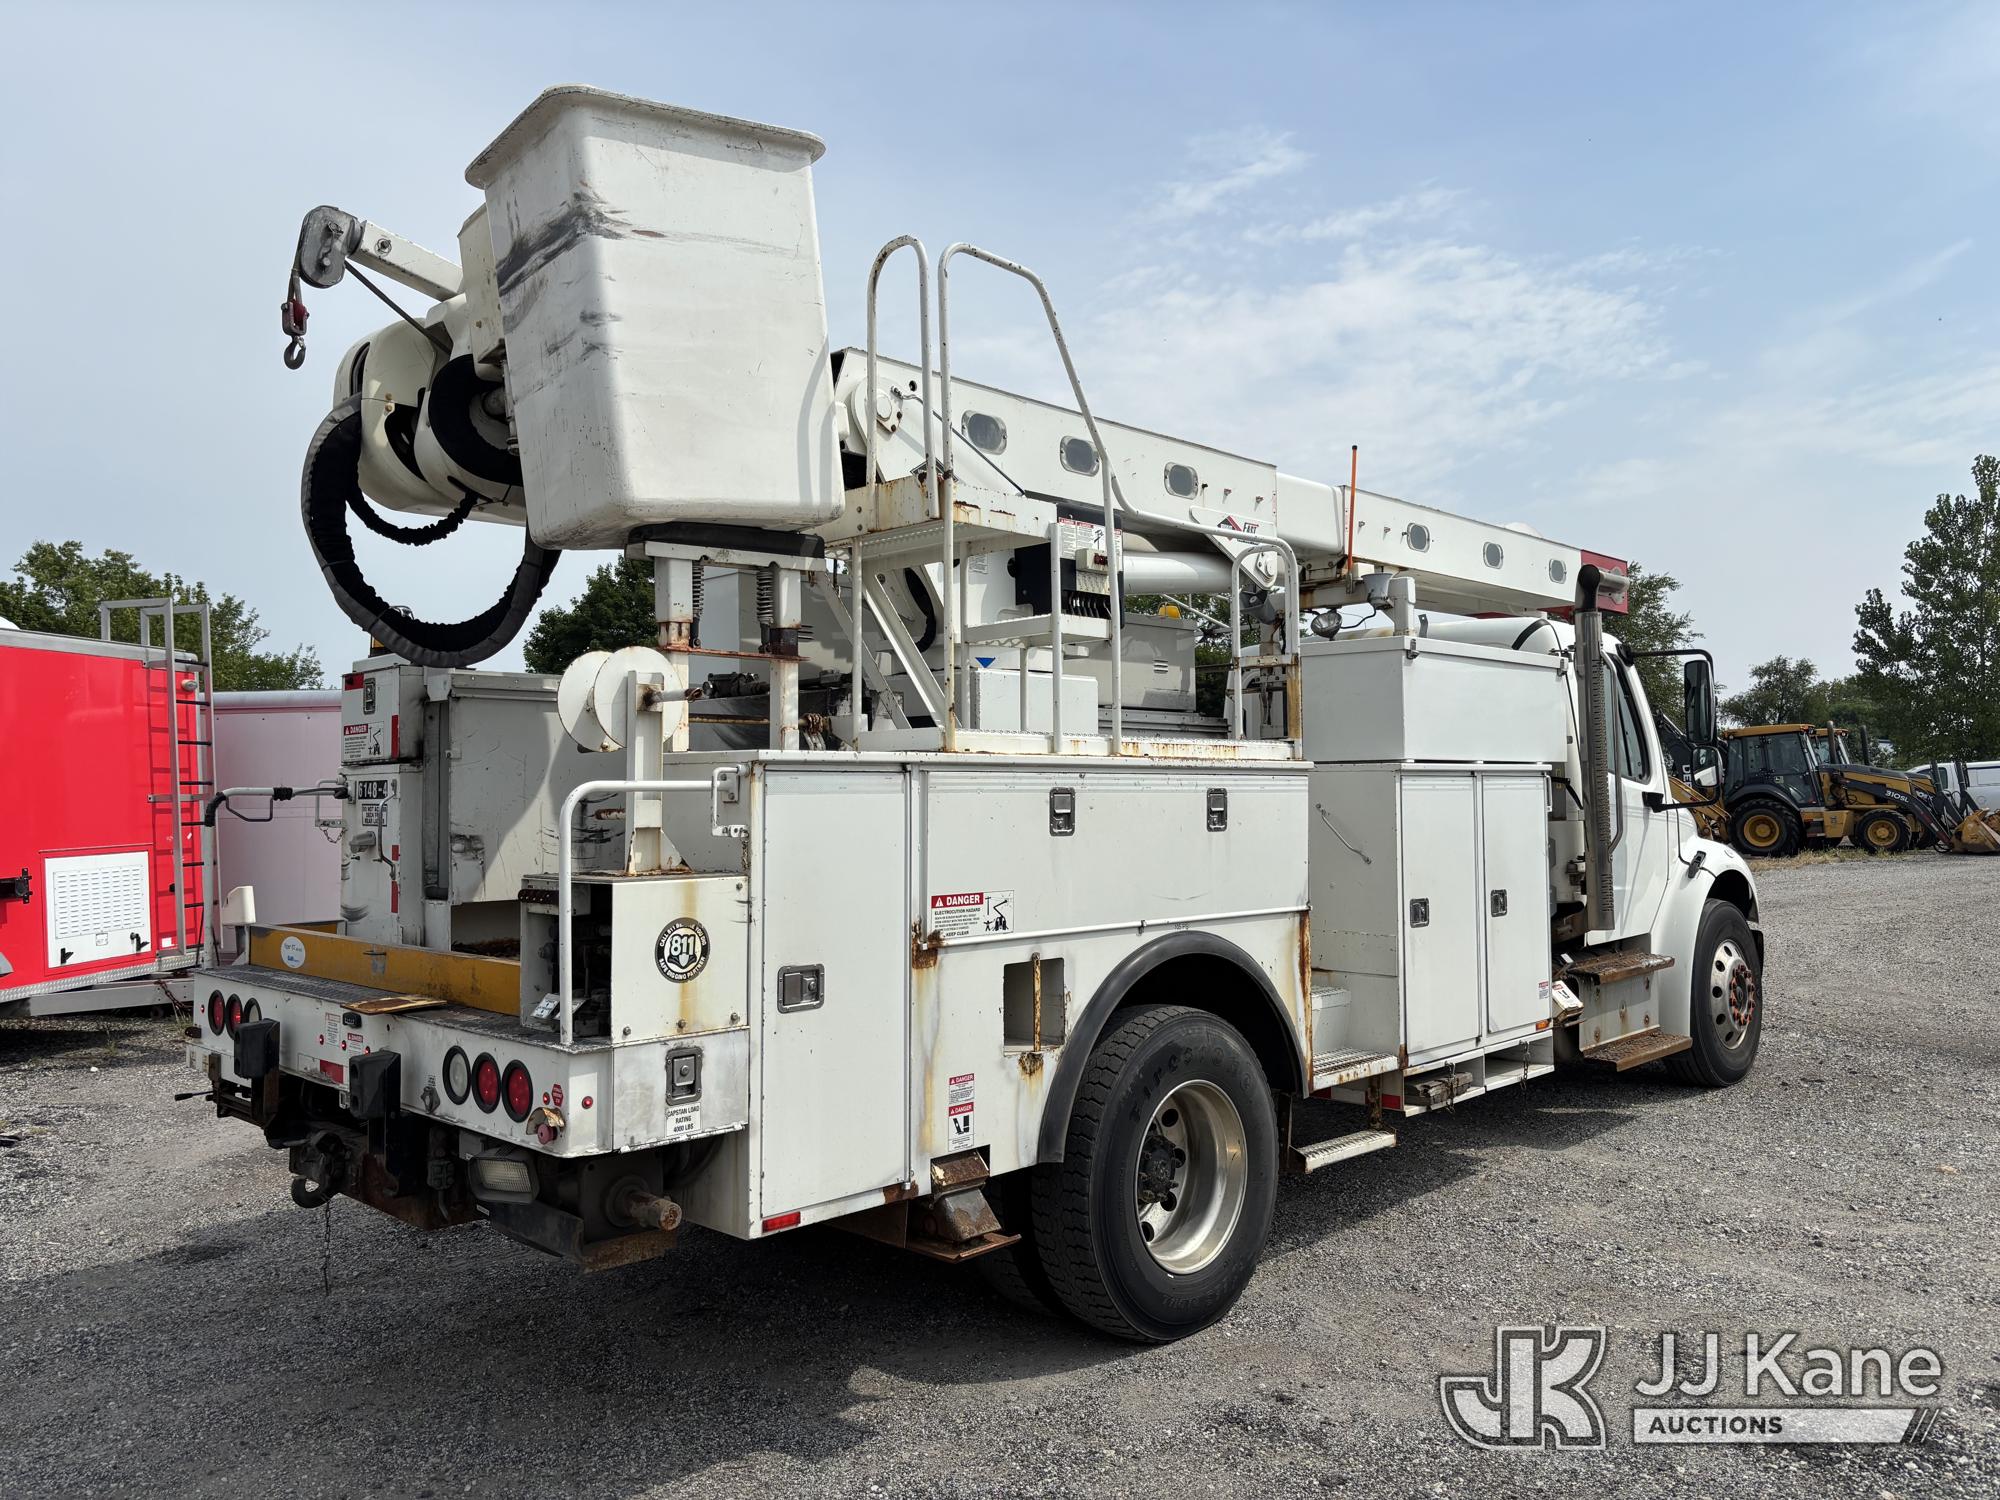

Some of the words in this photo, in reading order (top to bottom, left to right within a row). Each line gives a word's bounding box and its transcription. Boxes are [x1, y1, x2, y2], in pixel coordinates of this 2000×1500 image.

[358, 782, 388, 798] 6148-4
[1885, 790, 1910, 803] 310SL
[946, 894, 980, 906] DANGER
[671, 935, 694, 956] 811
[667, 1108, 687, 1117] CAPSTAN
[687, 1105, 700, 1113] LOAD
